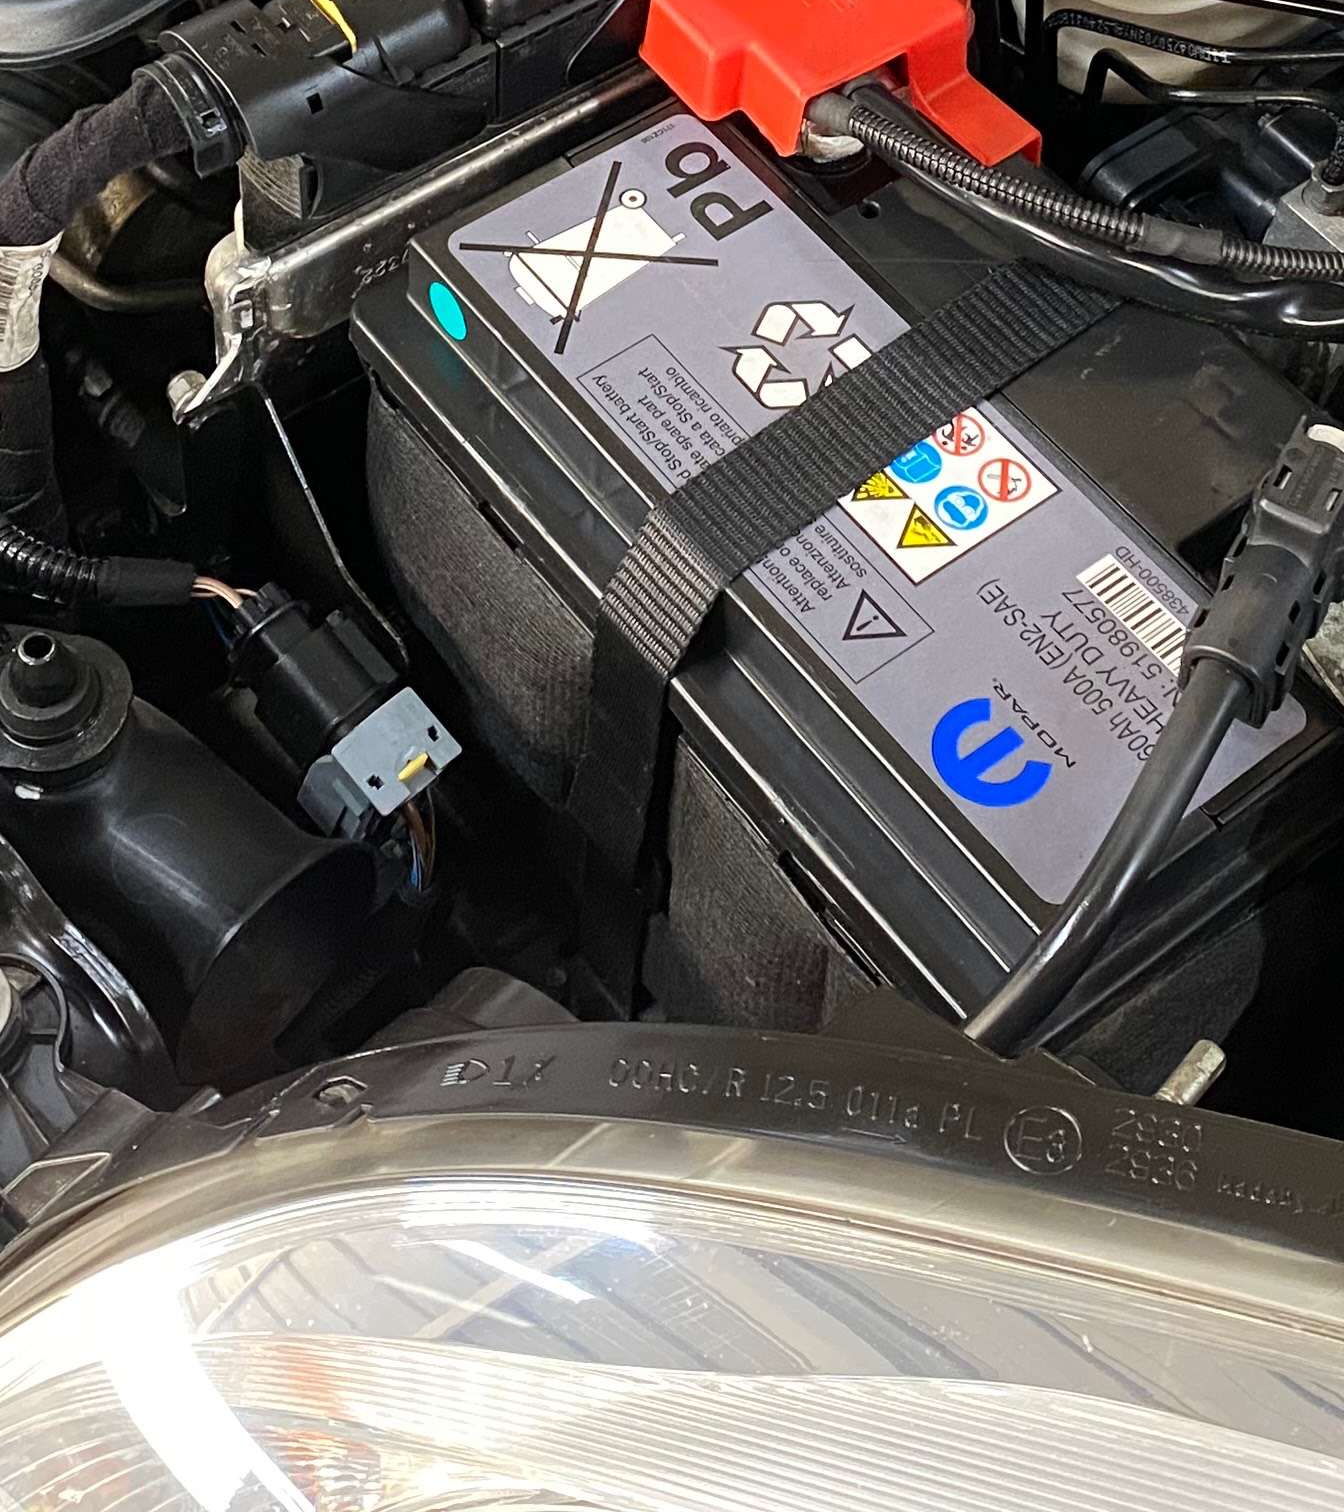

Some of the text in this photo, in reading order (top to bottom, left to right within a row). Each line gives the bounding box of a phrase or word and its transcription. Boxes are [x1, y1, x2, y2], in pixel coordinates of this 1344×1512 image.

[664, 141, 774, 242] Pb
[590, 374, 631, 415] battery
[636, 394, 666, 419] part
[637, 366, 694, 424] Stop/Start
[662, 364, 712, 415] ricambio
[624, 411, 683, 470] Stop/Start
[659, 417, 693, 451] spare
[689, 420, 703, 432] a
[812, 523, 868, 578] sostituire
[786, 556, 832, 602] replace
[1112, 542, 1190, 619] 438500-HD
[973, 576, 1074, 673] (EN2-SAE)
[1060, 584, 1164, 681] 51980577
[1039, 608, 1171, 734] HEAVY DUTY
[1060, 664, 1114, 717] 500A
[991, 680, 1077, 769] MOPAR
[938, 1101, 982, 1141] PL
